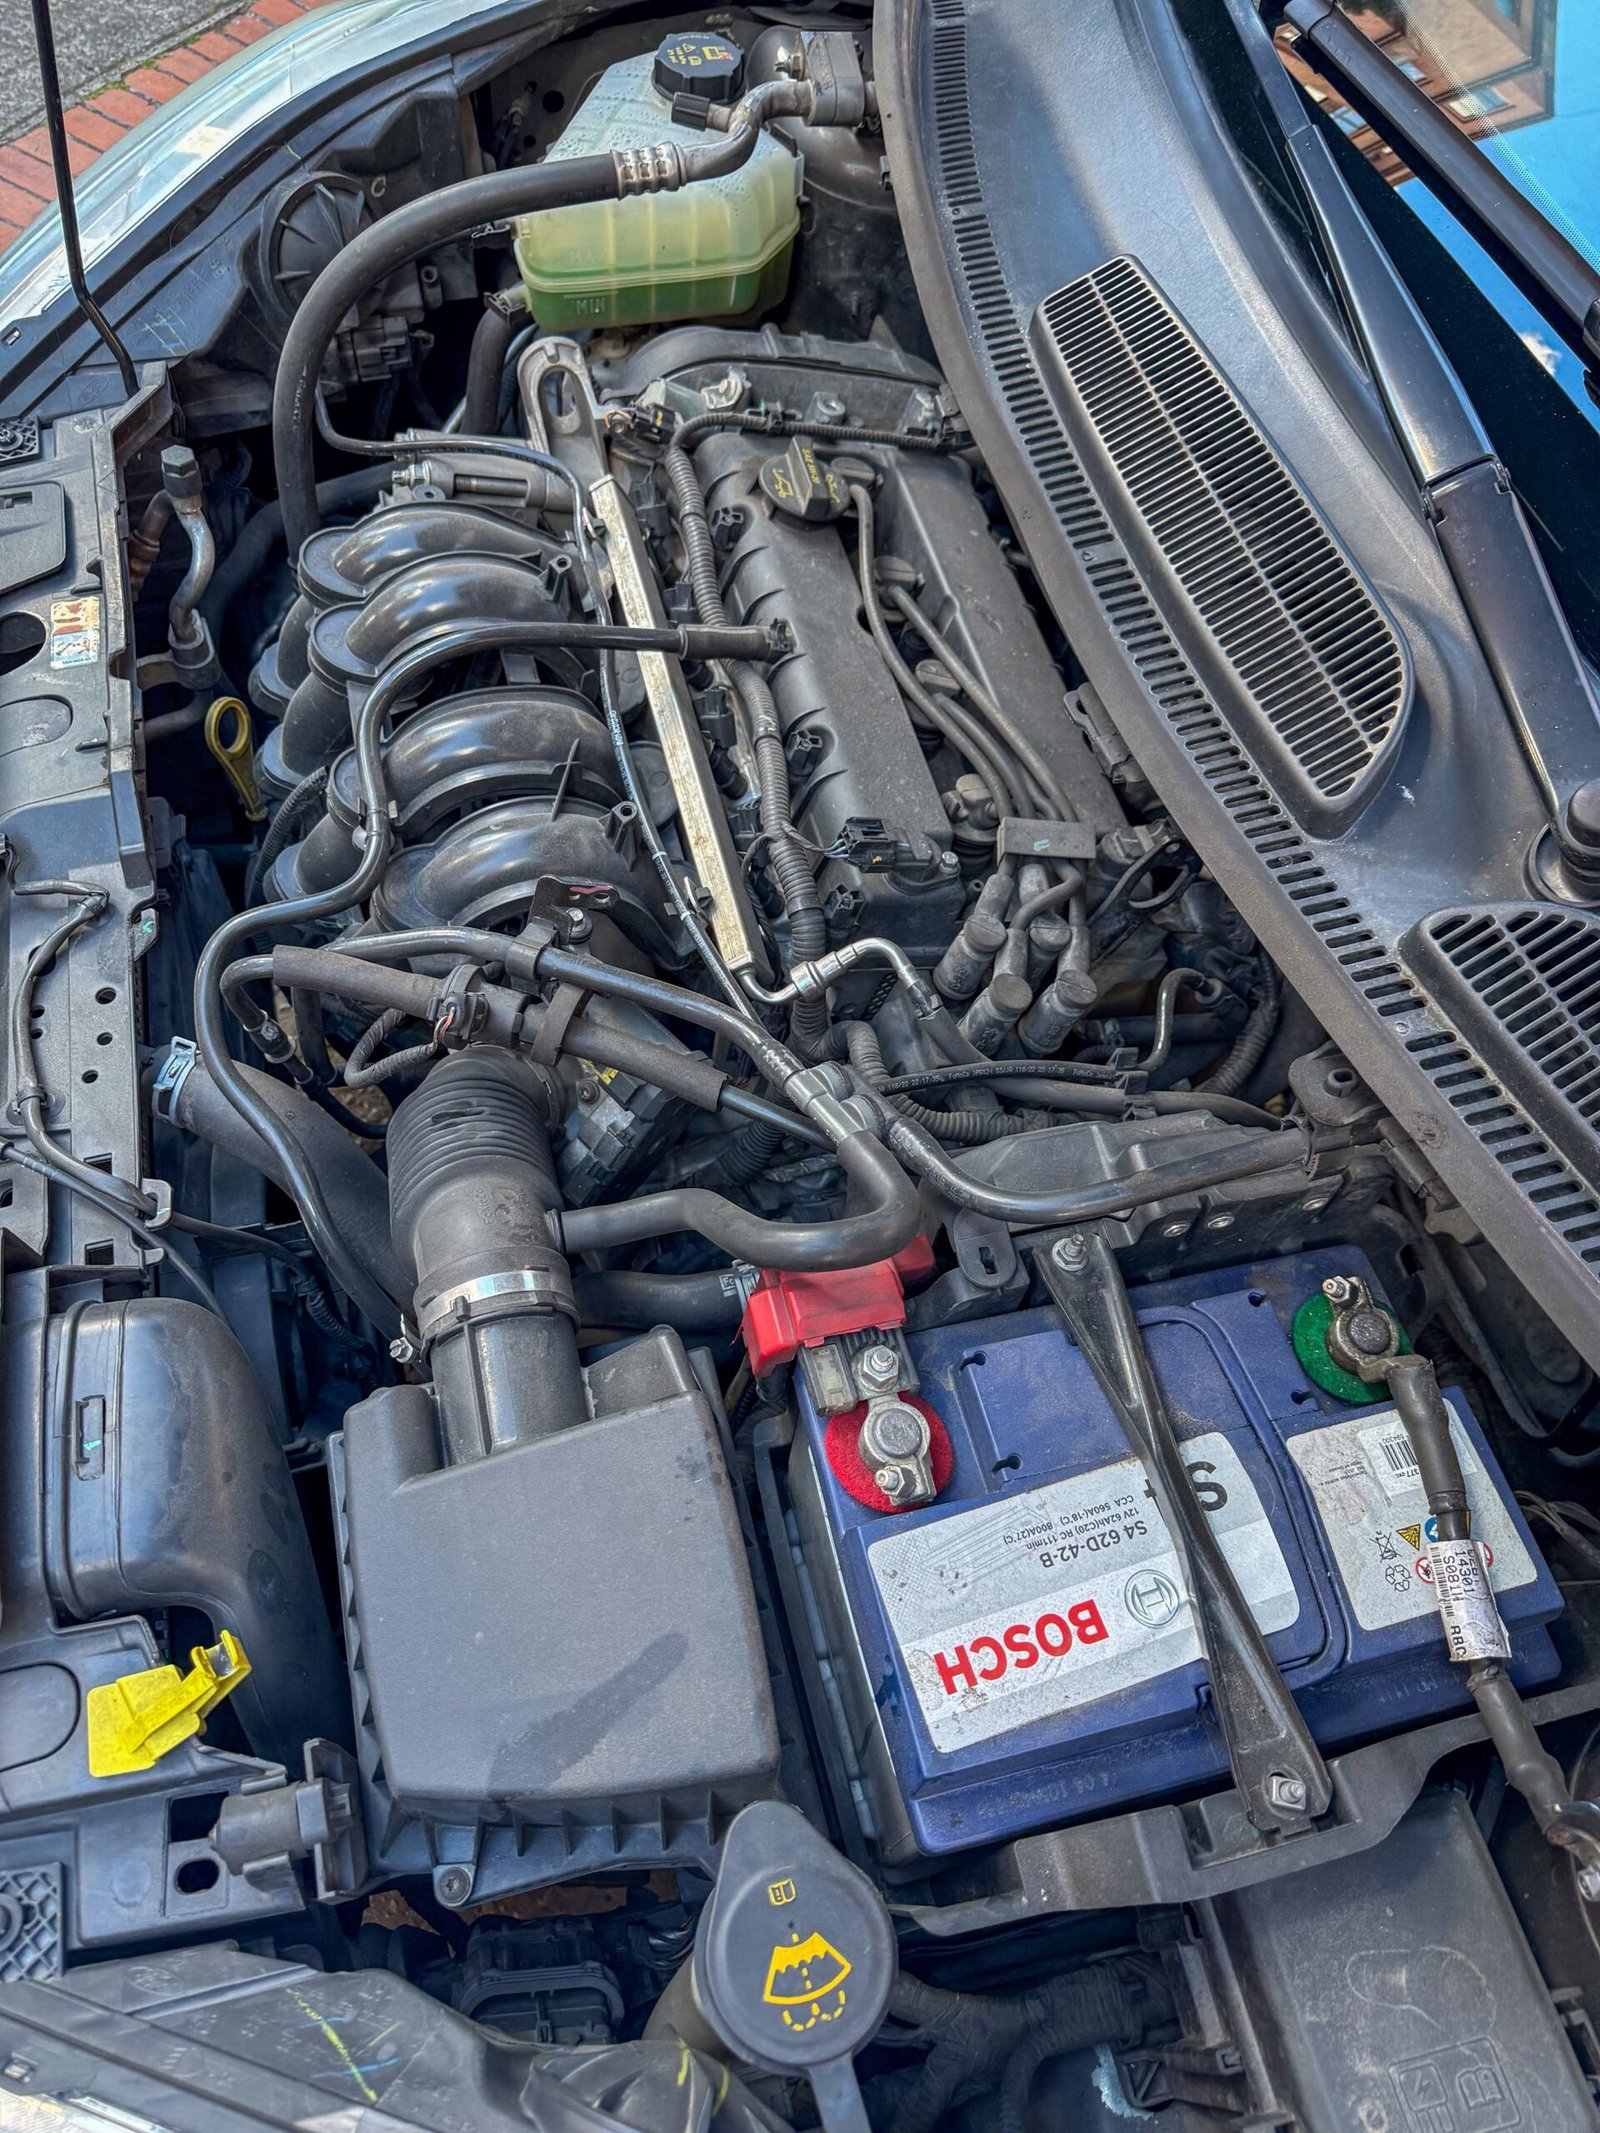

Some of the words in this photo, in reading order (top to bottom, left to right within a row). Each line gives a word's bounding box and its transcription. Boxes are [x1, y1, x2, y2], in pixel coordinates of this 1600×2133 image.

[576, 297, 606, 315] MIN
[1114, 1494, 1134, 1507] CCA
[1123, 1506, 1140, 1518] 12V
[1076, 1513, 1122, 1536] 62Ah(C20)
[1123, 1520, 1148, 1540] S4
[1026, 1533, 1058, 1550] 111min
[1059, 1529, 1074, 1540] RC
[1039, 1528, 1121, 1568] 62D-42-B
[1454, 1550, 1476, 1594] 14301
[933, 1598, 1110, 1696] BOSCH
